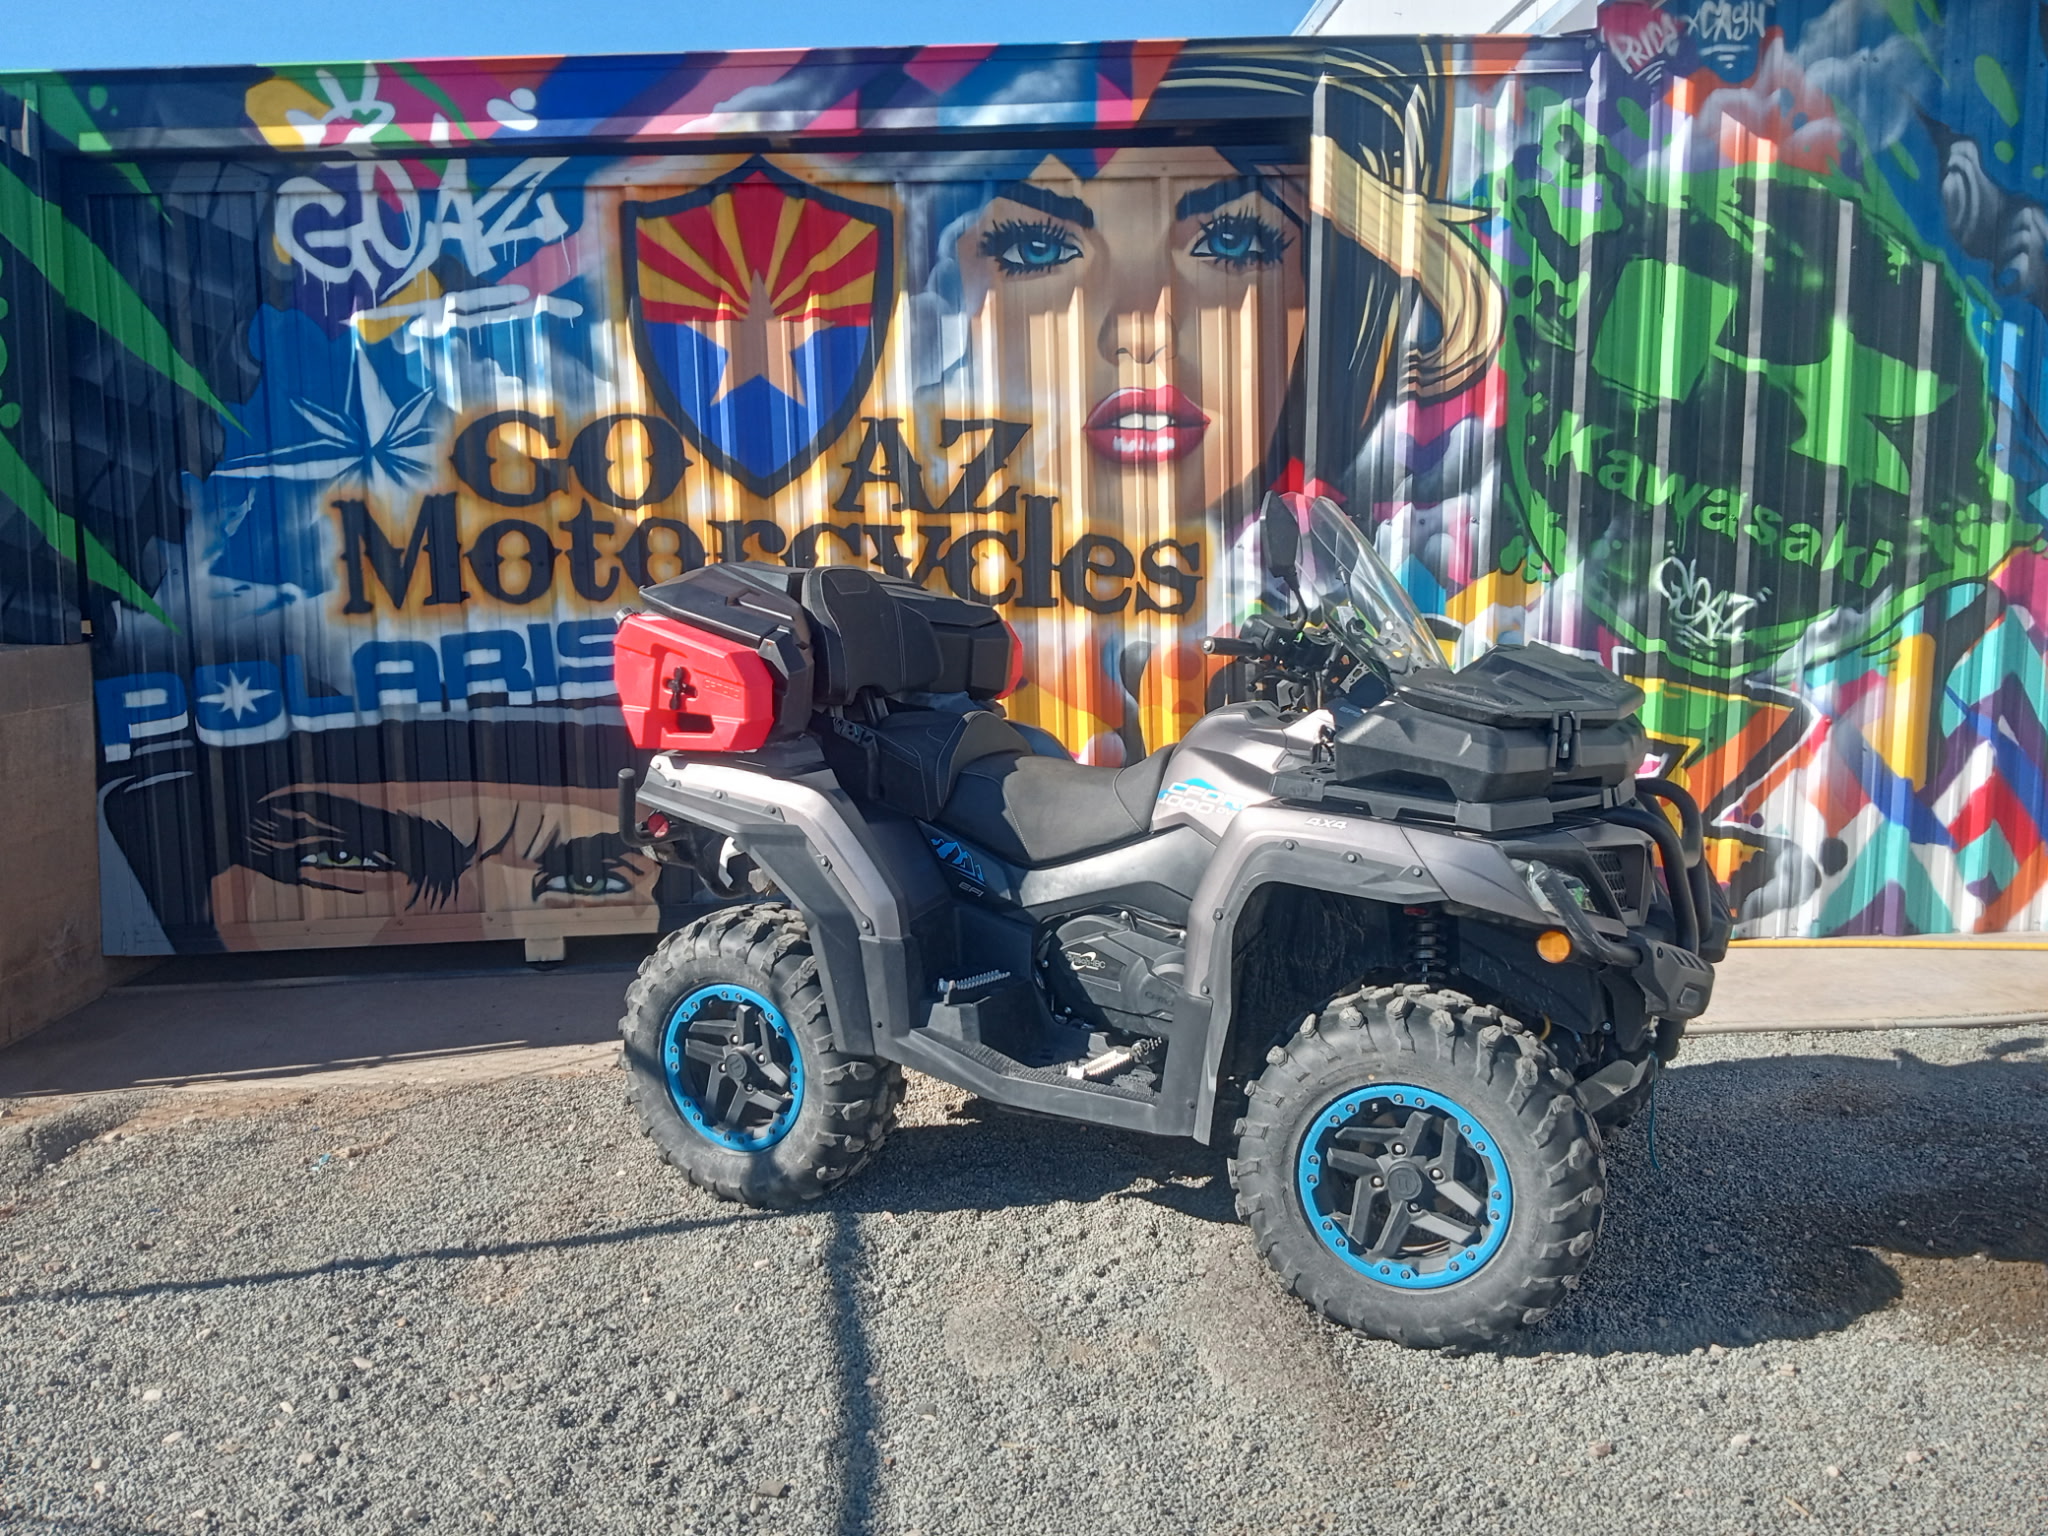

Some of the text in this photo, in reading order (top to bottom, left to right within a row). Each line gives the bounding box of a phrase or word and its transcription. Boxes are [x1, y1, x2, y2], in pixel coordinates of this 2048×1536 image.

[448, 409, 1033, 514] GO AZ
[1543, 409, 1895, 590] Kawasaki
[93, 617, 621, 763] POLARIS
[958, 881, 985, 897] EFI
